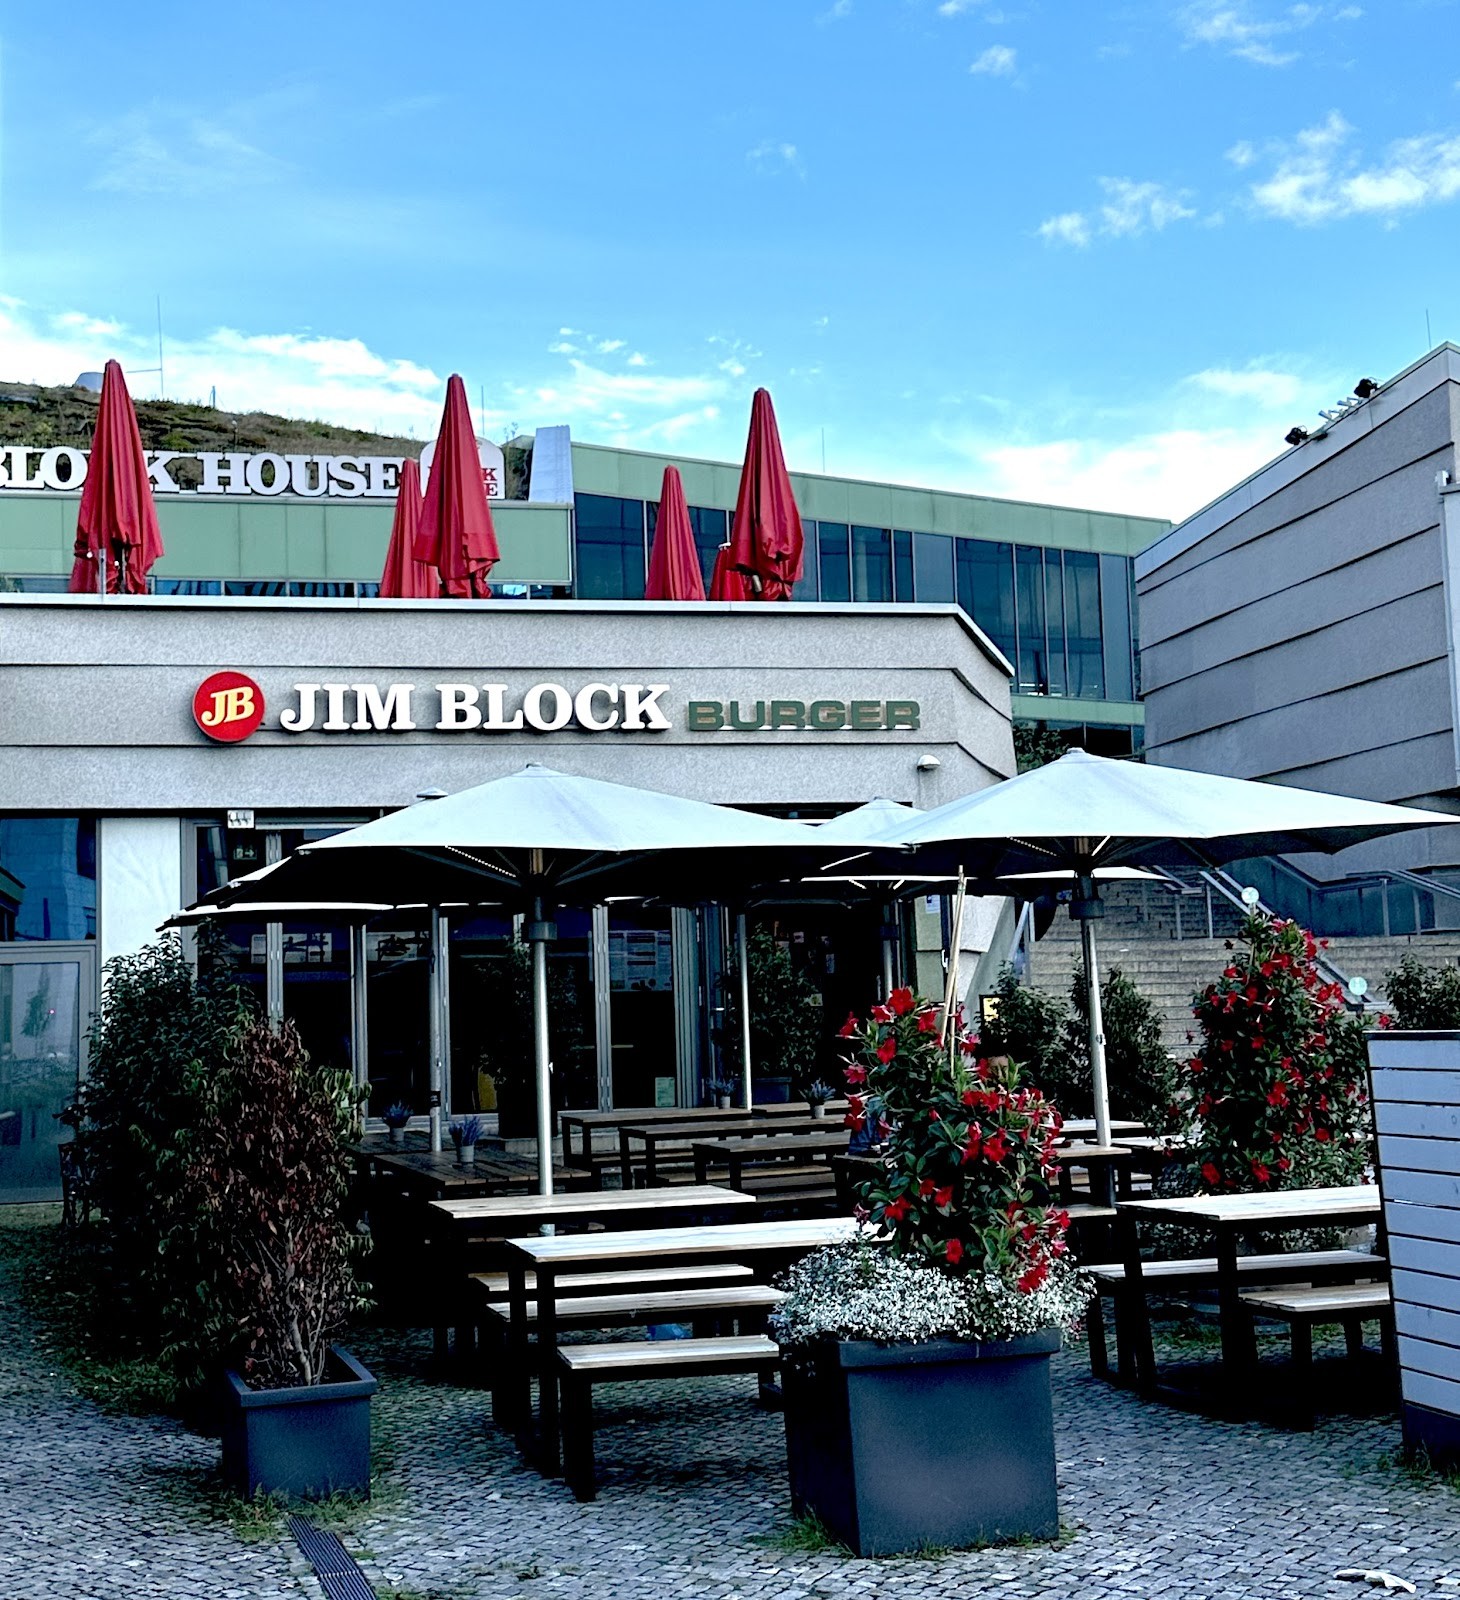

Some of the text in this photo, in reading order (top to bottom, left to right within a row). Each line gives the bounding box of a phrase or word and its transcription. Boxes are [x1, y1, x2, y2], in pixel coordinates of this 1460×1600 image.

[0, 446, 405, 498] LOK HOUSE
[201, 686, 255, 726] JB
[280, 683, 921, 731] JIM BLOCK BURGER
